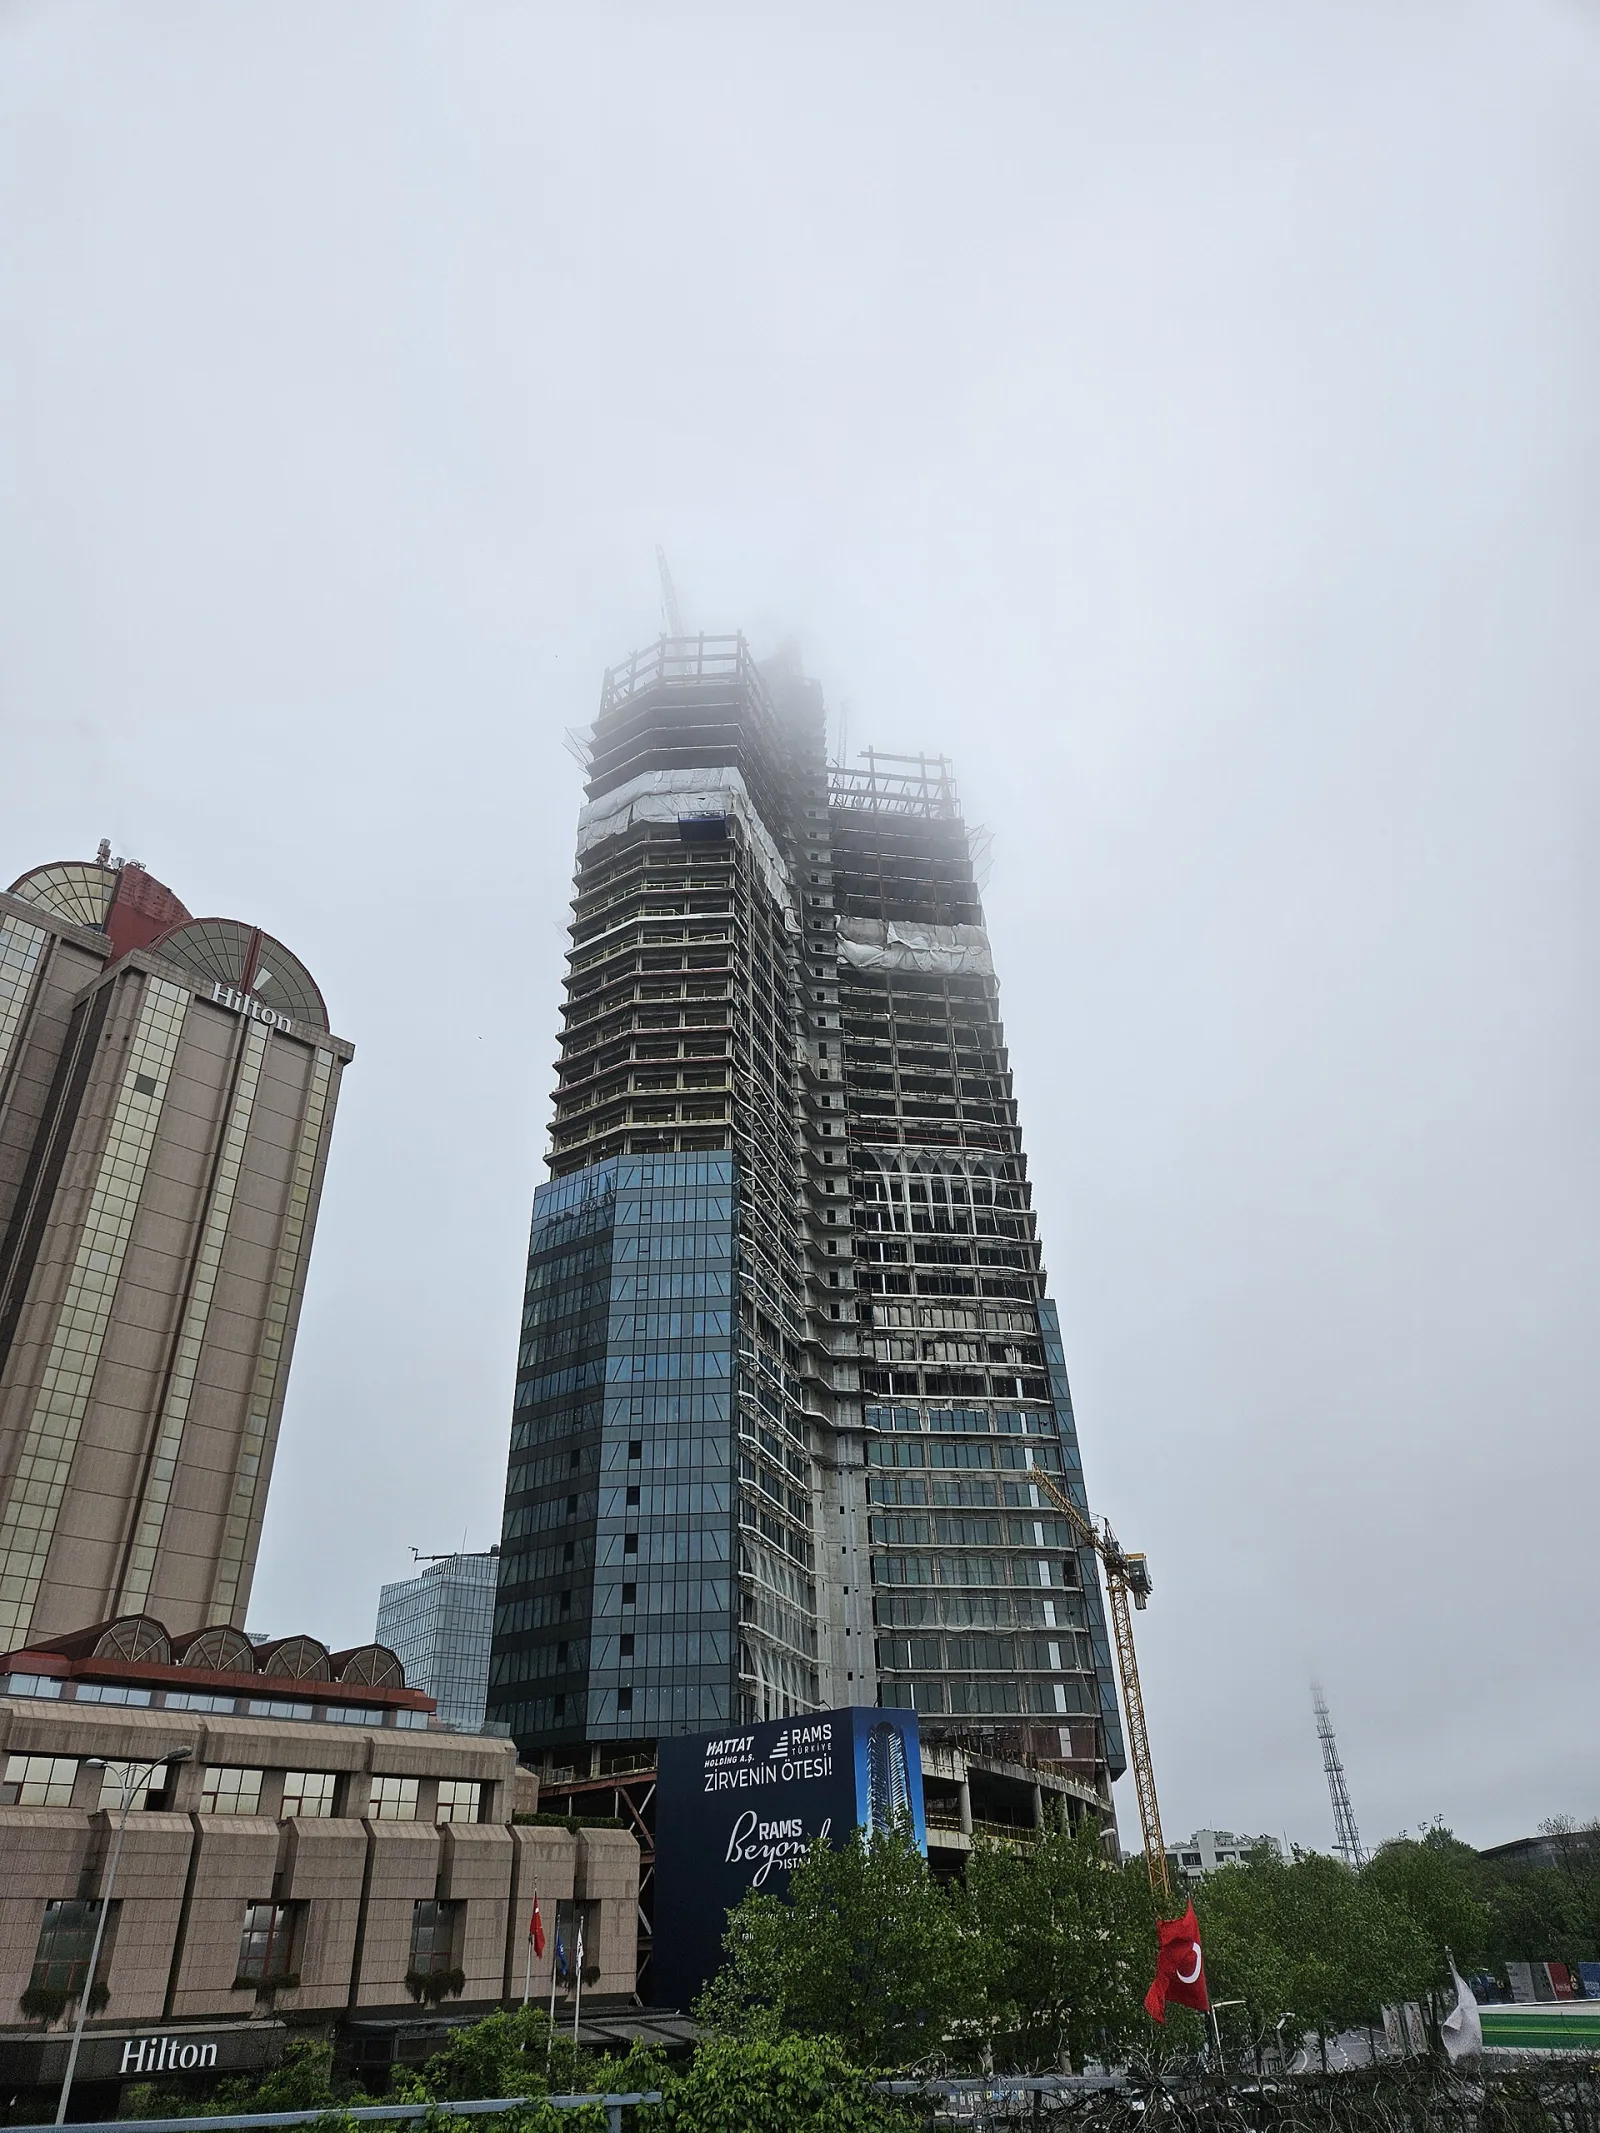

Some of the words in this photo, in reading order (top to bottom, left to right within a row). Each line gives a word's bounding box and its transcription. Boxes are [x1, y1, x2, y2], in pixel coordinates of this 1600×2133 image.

[211, 981, 292, 1034] Hilton
[792, 1723, 832, 1745] RAMS
[706, 1736, 755, 1756] HATTAT
[791, 1742, 832, 1756] TÜRKİYE
[704, 1762, 777, 1792] ZİRVENİN
[781, 1753, 832, 1781] ÖTESİ!
[759, 1819, 802, 1840] RAMS
[119, 2037, 218, 2074] Hilton
